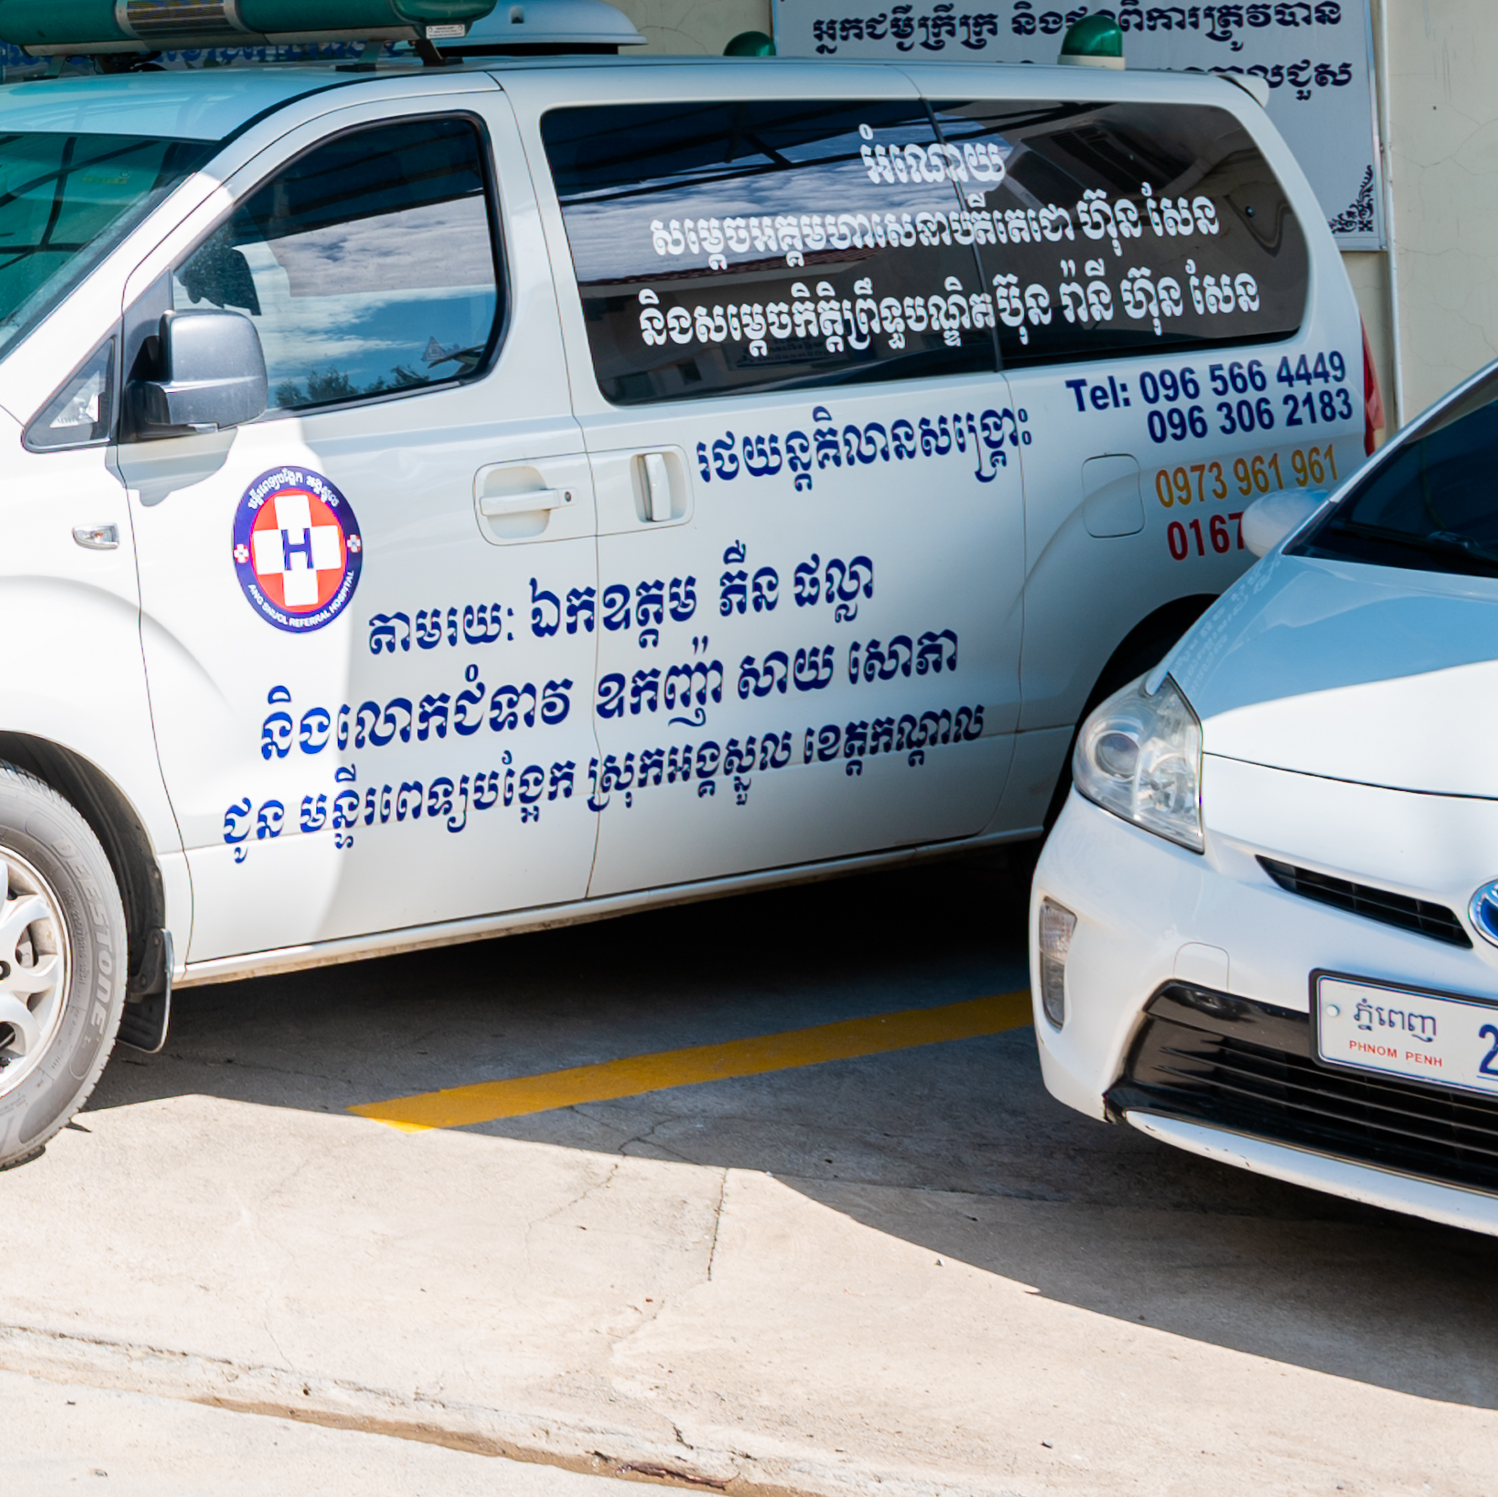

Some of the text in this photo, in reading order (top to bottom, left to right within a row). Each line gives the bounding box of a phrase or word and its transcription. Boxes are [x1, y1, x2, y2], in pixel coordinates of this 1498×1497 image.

[859, 124, 1006, 185] អំណោយ
[1078, 189, 1143, 255] ហ៊ុន
[1148, 182, 1220, 237] សែន
[1060, 260, 1115, 324] រ៉ានី
[1122, 265, 1184, 338] ហ៊ុន
[1189, 259, 1261, 315] សែន
[1065, 351, 1346, 412] Tel: 096 566 4449
[1148, 388, 1353, 444] 096 306 2183
[1154, 444, 1339, 509] 0973 961 961
[248, 583, 264, 602] ANG
[289, 608, 332, 628] REFERRAL
[329, 570, 355, 614] HOSPITAL
[261, 664, 574, 760] និងលោកជំទាវ
[737, 643, 835, 700] សាយ
[848, 628, 959, 684] សោភា
[222, 798, 285, 864] ជូន
[299, 750, 576, 850] មន្ទីរពេទ្យបង្អែក
[52, 838, 114, 1039] DEESTONE
[1353, 997, 1437, 1043] ភ្នំពេញ
[1349, 1039, 1443, 1068] PHNOM PENH
